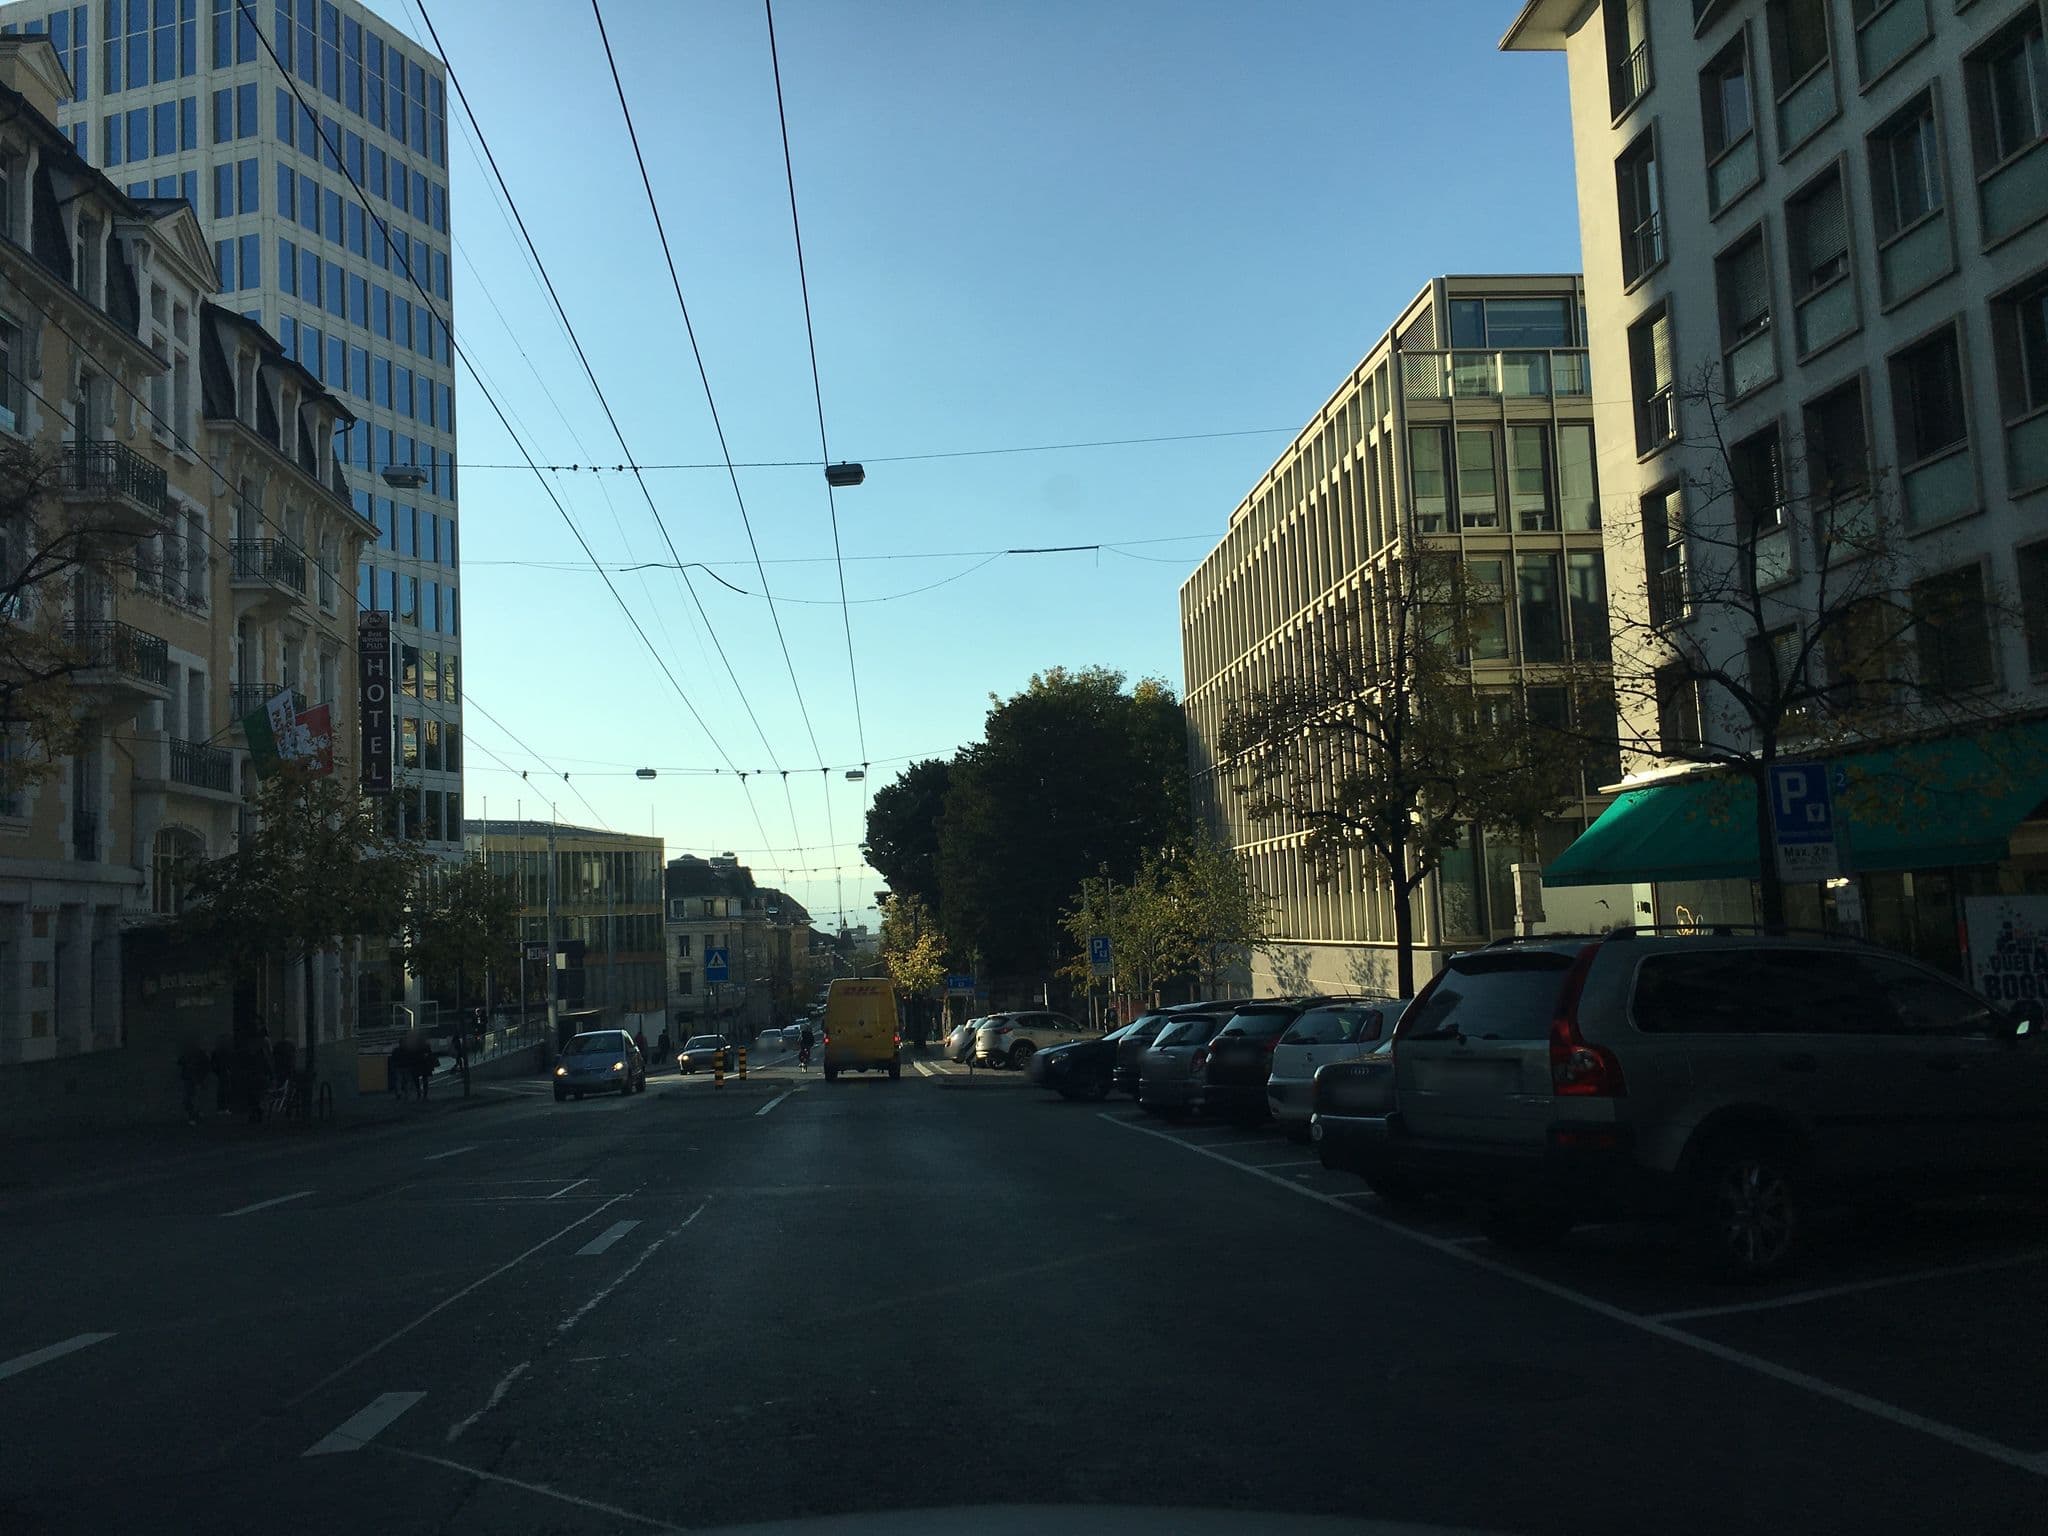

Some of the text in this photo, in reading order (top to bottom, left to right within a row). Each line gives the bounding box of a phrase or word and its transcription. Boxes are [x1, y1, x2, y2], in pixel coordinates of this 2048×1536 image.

[367, 658, 385, 780] HOTEL
[1777, 771, 1807, 814] P
[1093, 940, 1103, 954] P
